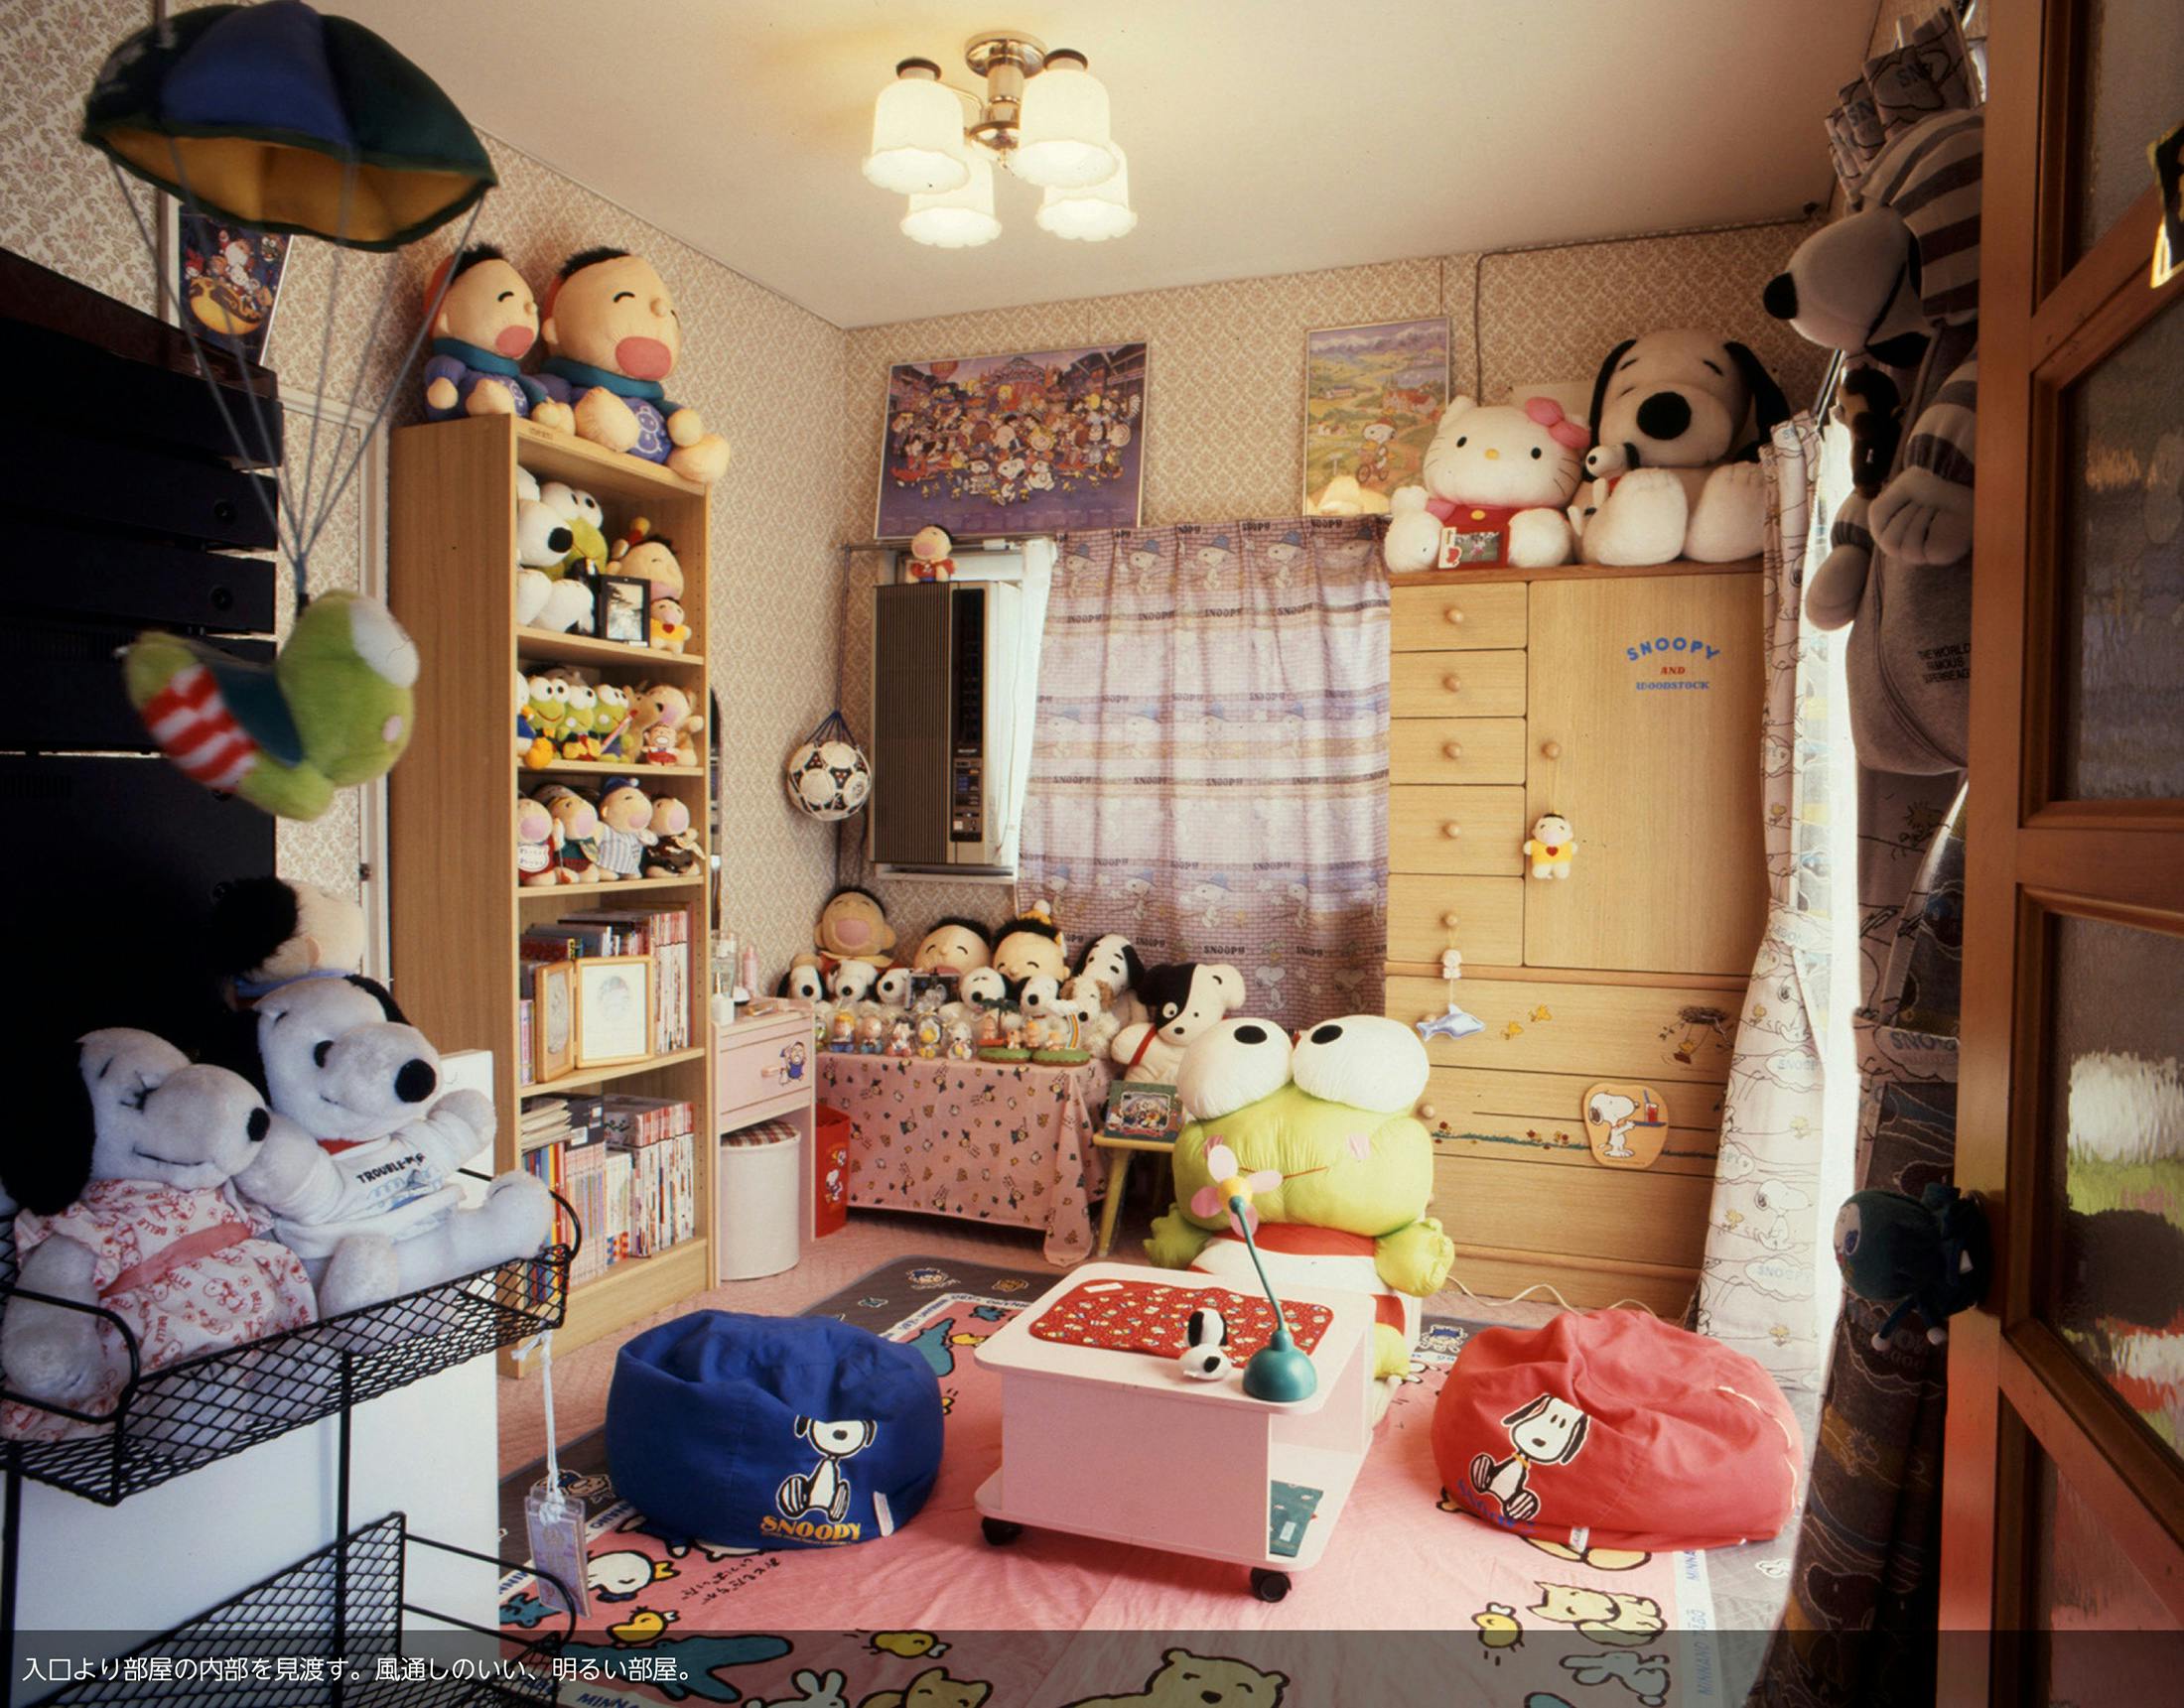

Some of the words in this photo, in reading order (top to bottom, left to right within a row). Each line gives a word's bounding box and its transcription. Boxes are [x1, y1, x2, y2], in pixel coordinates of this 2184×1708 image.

[1627, 637, 1720, 661] SNOOPY
[1660, 666, 1686, 675] AND
[1636, 682, 1710, 691] WOODSTOCK
[760, 1515, 861, 1540] SNOOPY
